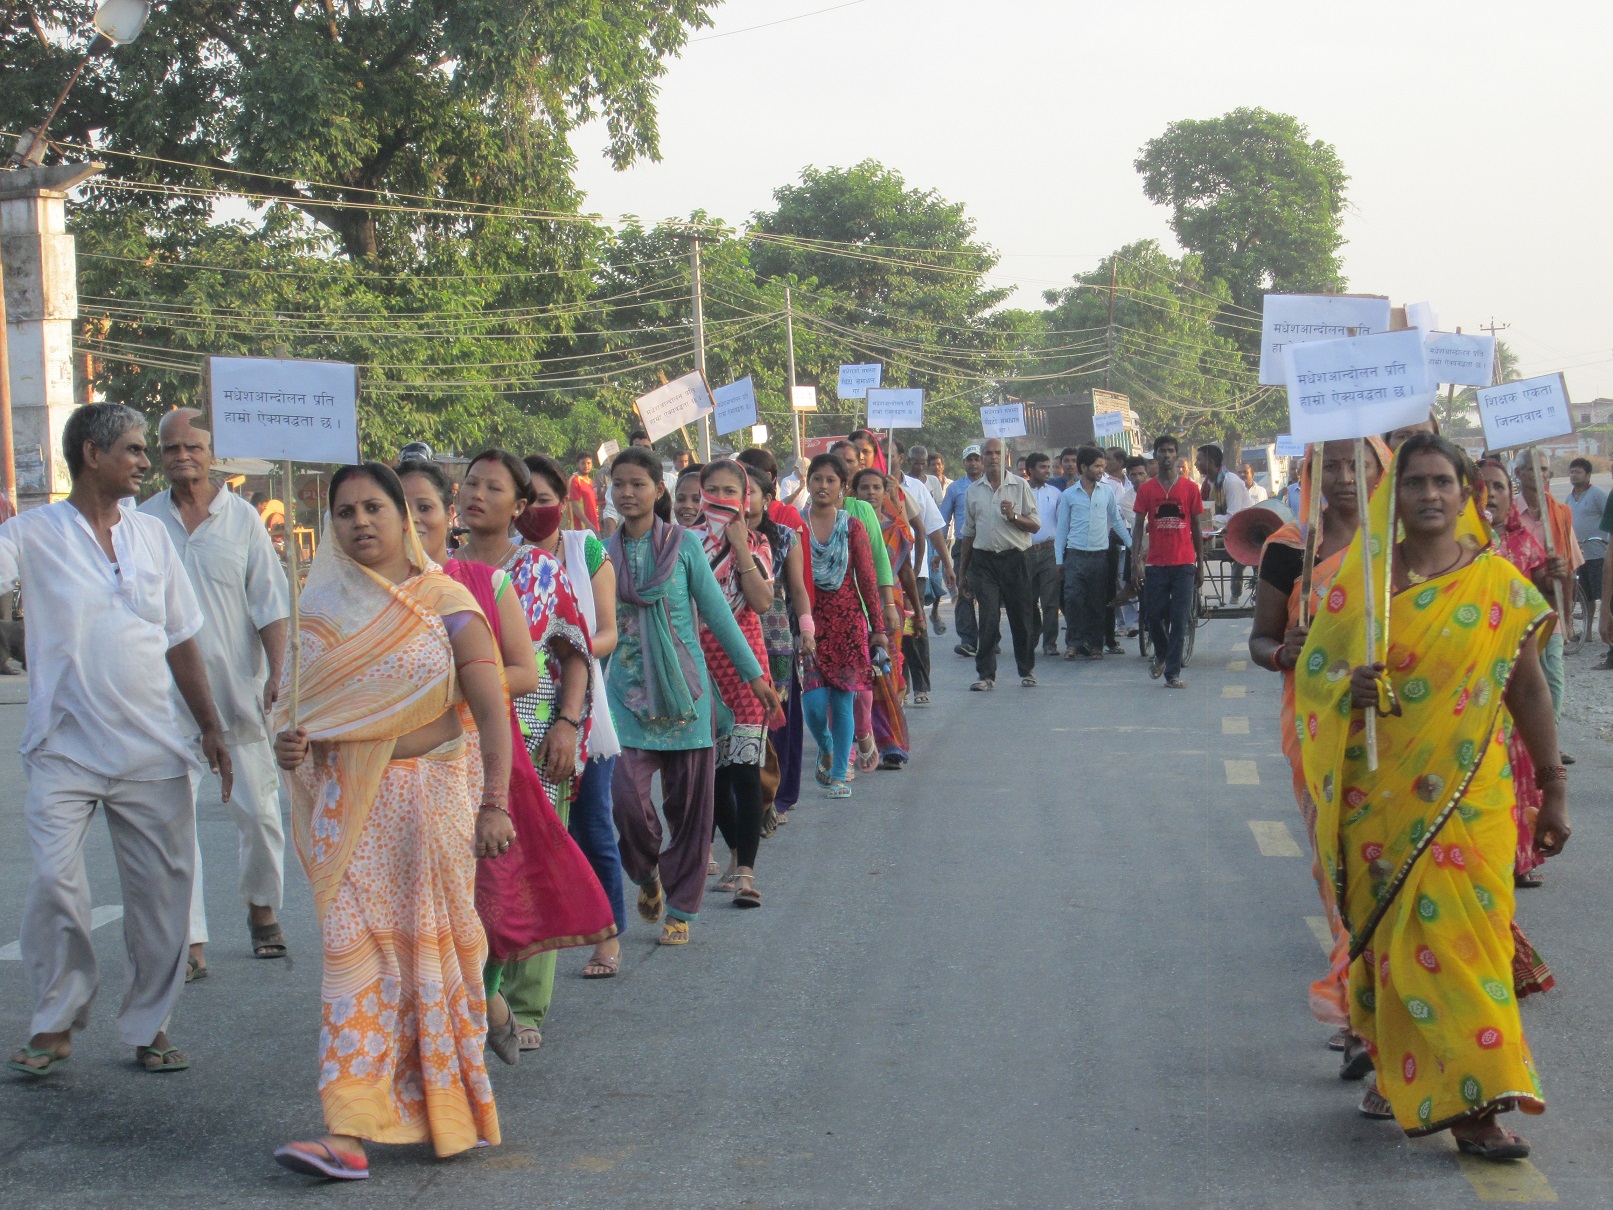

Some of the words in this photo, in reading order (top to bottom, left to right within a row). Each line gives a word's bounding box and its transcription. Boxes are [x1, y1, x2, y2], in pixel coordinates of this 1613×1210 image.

[1274, 320, 1346, 335] मधेशआन्दोलन
[1297, 366, 1378, 386] मधेशआन्दोलन
[1384, 360, 1407, 376] प्रति
[224, 387, 306, 404] मधेशआन्दोलन
[313, 392, 335, 406] प्रति
[1300, 392, 1325, 407] हाम्रो
[1484, 390, 1518, 408] शिक्षक
[1523, 384, 1552, 402] एकता
[224, 409, 250, 424] हाम्रो
[1494, 410, 1542, 428] जिन्दावाद
